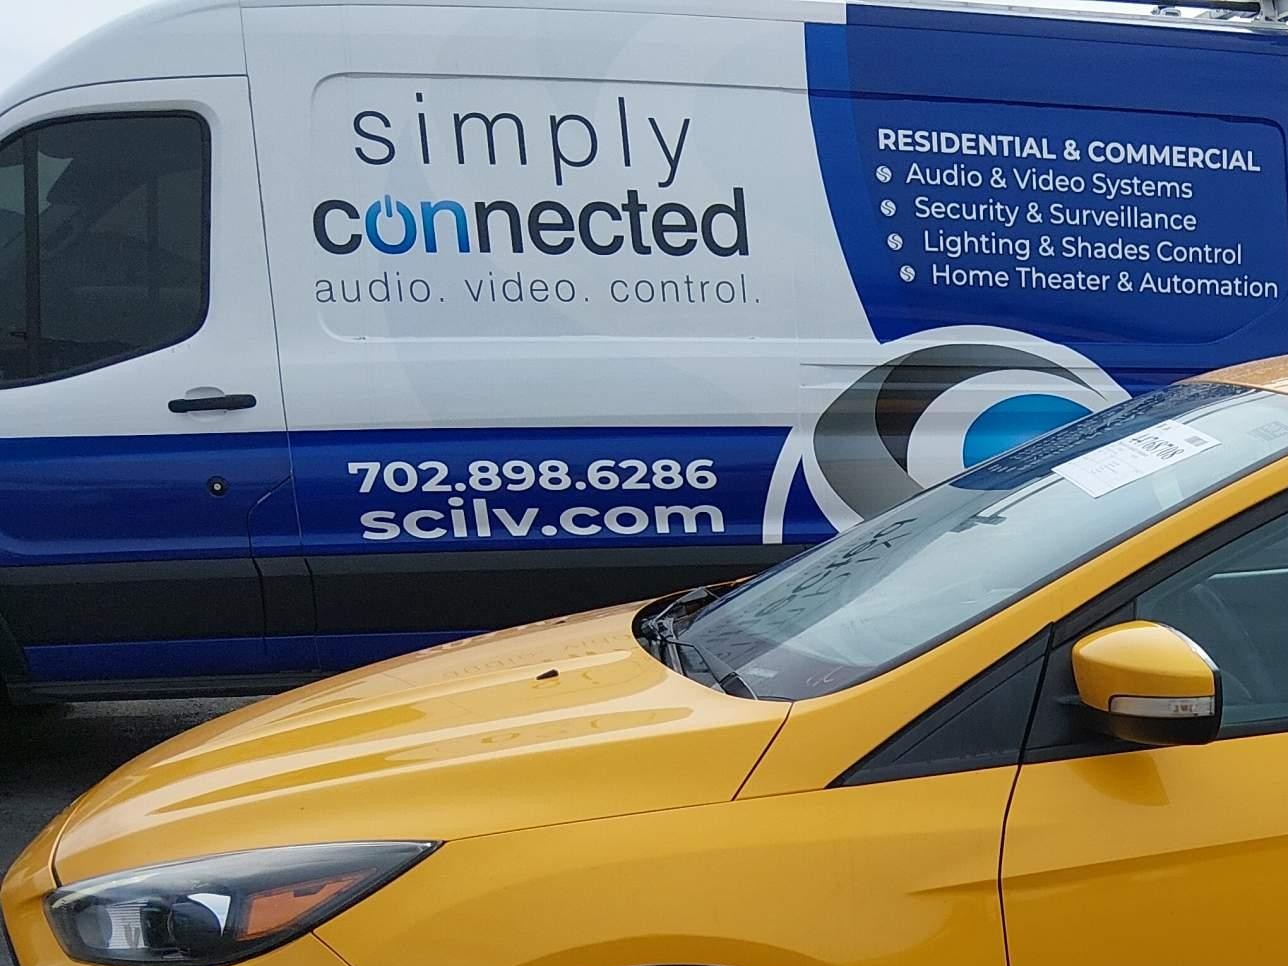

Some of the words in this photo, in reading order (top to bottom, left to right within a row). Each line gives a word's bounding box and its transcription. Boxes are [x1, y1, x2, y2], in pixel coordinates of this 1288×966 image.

[353, 92, 691, 188] simply
[878, 128, 1057, 160] RESIDENTIAL
[1063, 140, 1081, 161] &
[1087, 141, 1262, 172] COMMERCIAL
[906, 163, 983, 187] Audio
[990, 166, 1007, 189] &
[1013, 168, 1085, 193] Video
[1092, 173, 1193, 200] Systems
[312, 187, 750, 257] connected
[914, 196, 1019, 227] Security
[1026, 202, 1043, 224] &
[1049, 203, 1198, 231] Surveillance
[923, 230, 1030, 260] Lighting
[1039, 236, 1055, 257] &
[1062, 236, 1150, 261] Shades
[1156, 241, 1242, 265] Control
[314, 271, 445, 303] audio.
[464, 271, 590, 303] video.
[610, 274, 761, 304] control.
[932, 264, 1010, 287] Home
[1016, 266, 1110, 293] Theater
[1117, 271, 1133, 293] &
[1139, 272, 1279, 299] Automation
[347, 459, 718, 493] 702.898.6286
[359, 496, 725, 540] scilv.com
